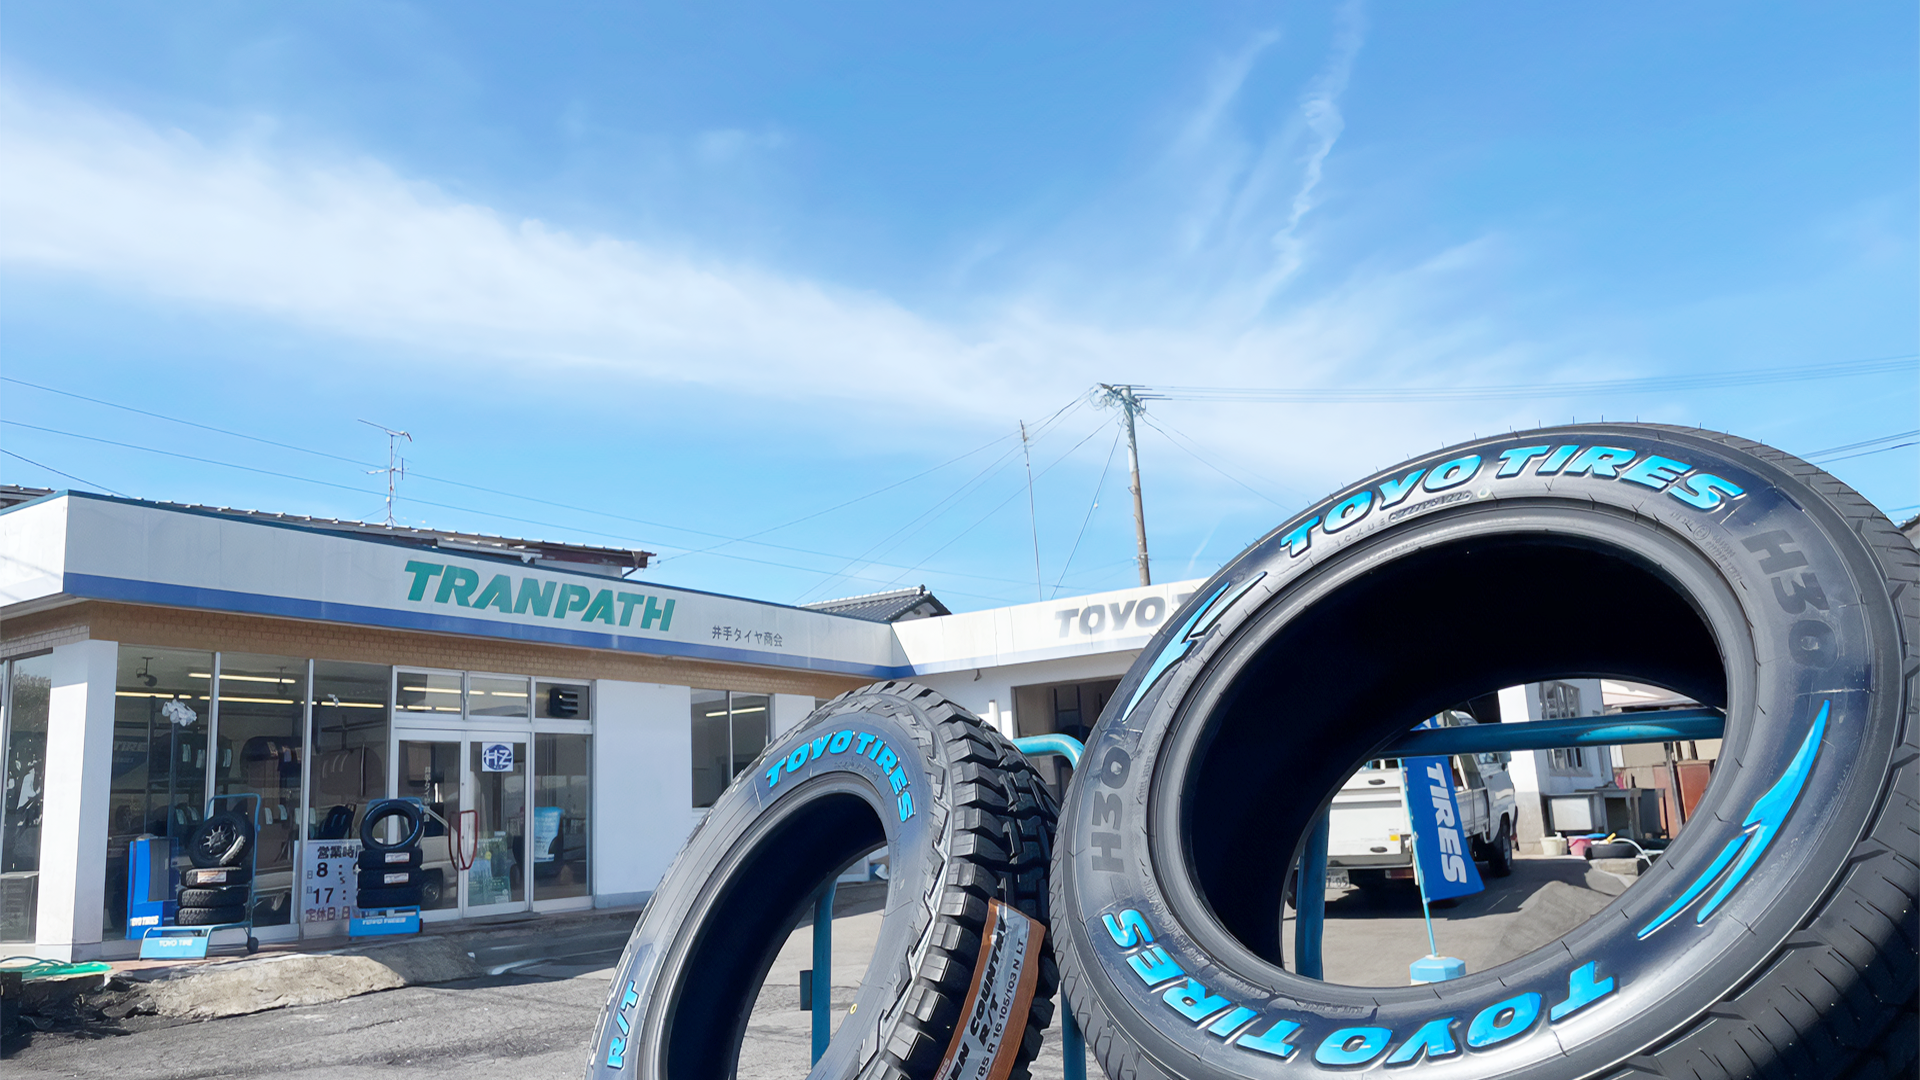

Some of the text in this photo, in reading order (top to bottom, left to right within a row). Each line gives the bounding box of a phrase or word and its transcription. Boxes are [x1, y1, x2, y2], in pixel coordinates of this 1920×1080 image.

[1280, 444, 1745, 557] TOYO TIRES
[404, 560, 676, 632] TRANPATH
[1055, 596, 1166, 638] TOYO
[712, 625, 783, 647] 井手タイヤ商会
[766, 729, 916, 822] TOYO TIRES
[1427, 763, 1467, 883] TIRES
[1012, 961, 1021, 971] N
[1016, 938, 1025, 955] LT
[1000, 974, 1018, 1019] 105/103
[1102, 908, 1301, 1058] TIRES
[606, 980, 639, 1070] R/T
[979, 993, 999, 1047] R/T
[993, 1023, 1003, 1038] 16
[1315, 959, 1617, 1065] TOYO
[948, 1041, 970, 1080] EN
[986, 1042, 997, 1054] R
